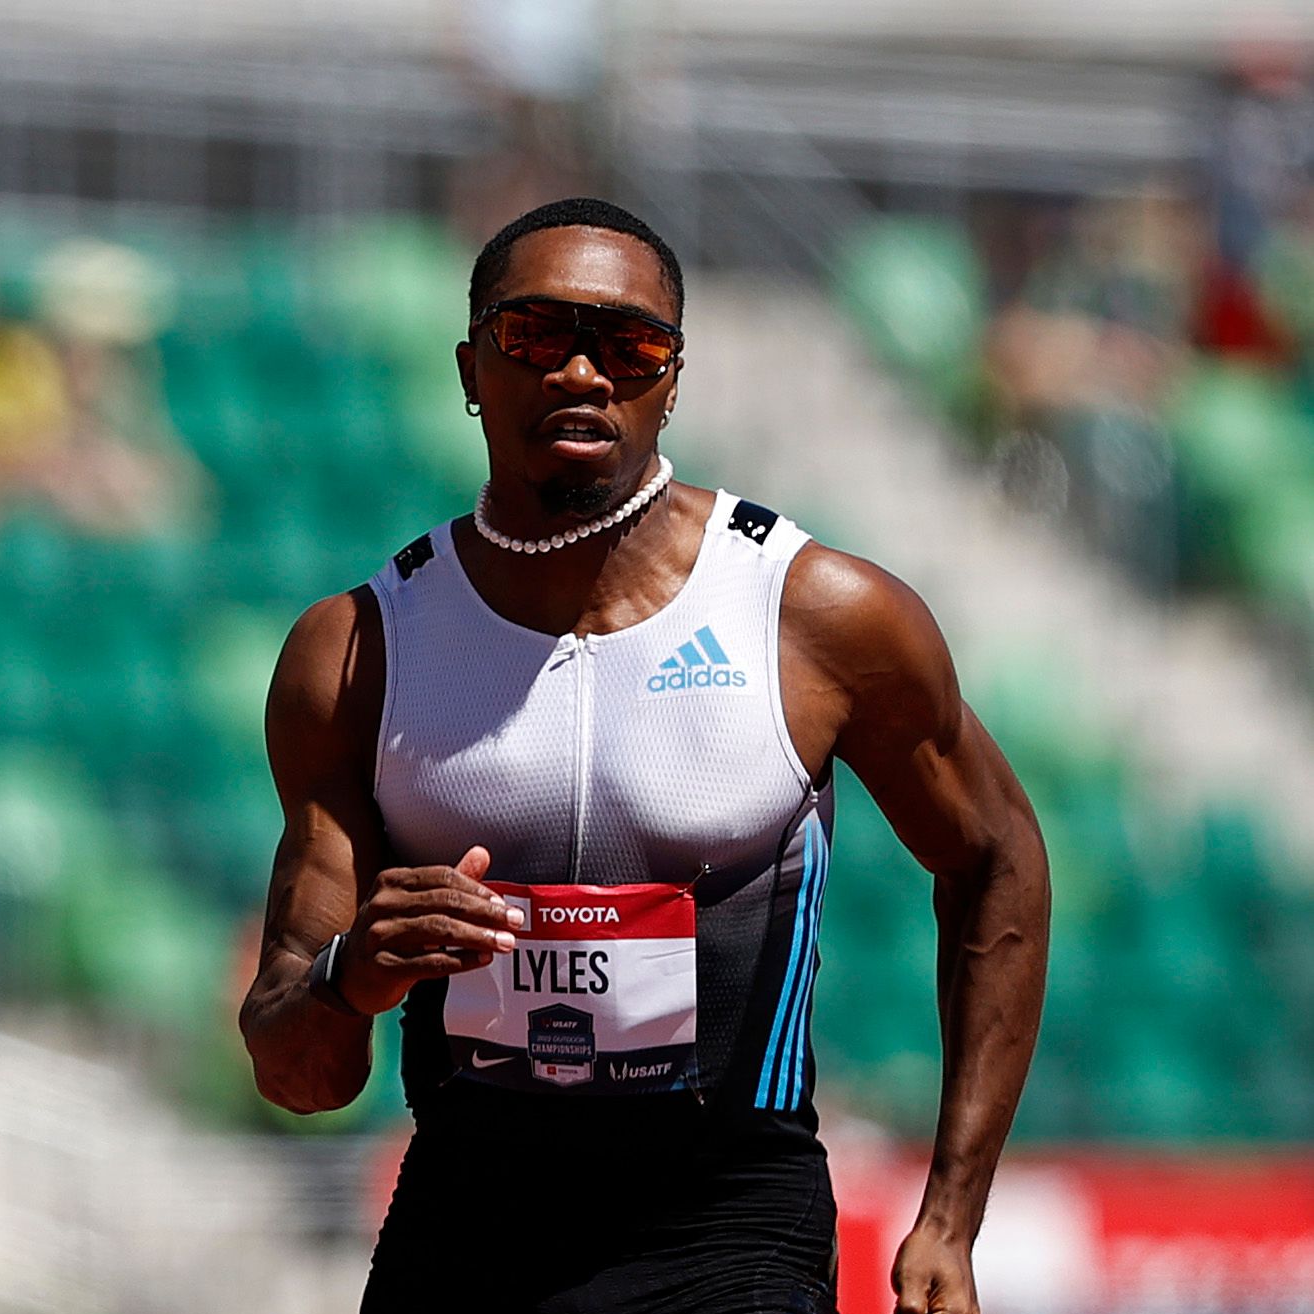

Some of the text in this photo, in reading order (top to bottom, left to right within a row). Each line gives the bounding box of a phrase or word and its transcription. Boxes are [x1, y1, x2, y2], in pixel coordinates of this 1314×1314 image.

[647, 664, 746, 692] adidas
[538, 906, 620, 923] TOYOTA
[513, 948, 609, 995] LYLES
[628, 1062, 673, 1079] USATF
